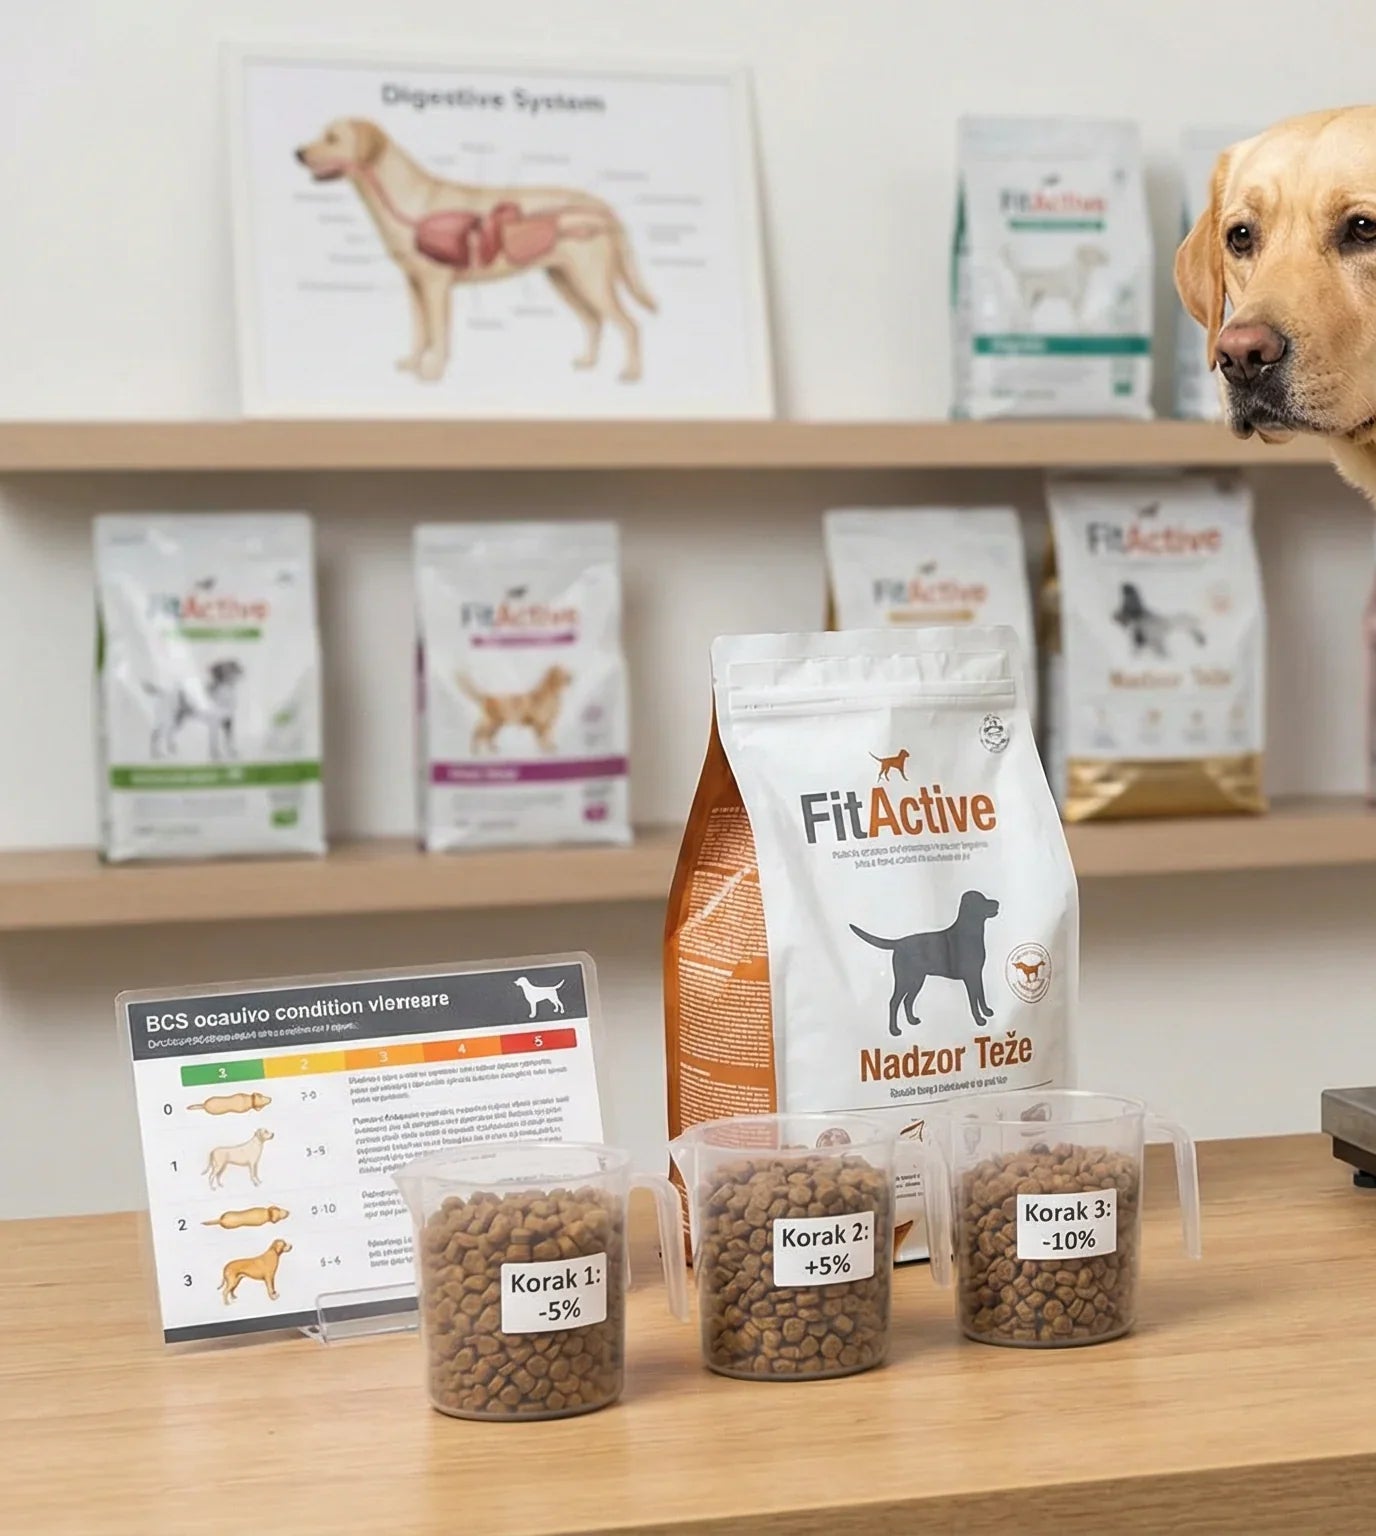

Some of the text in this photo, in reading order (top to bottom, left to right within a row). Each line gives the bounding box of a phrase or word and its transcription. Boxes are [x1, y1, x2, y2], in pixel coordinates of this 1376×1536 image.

[382, 83, 606, 117] Digestive System
[1087, 520, 1222, 556] FitActive
[800, 784, 997, 845] FitActive
[146, 1012, 189, 1033] BCS
[194, 1006, 270, 1028] ocauivo
[275, 999, 364, 1021] condition
[300, 1058, 310, 1071] 2
[379, 1050, 389, 1062] 3
[458, 1043, 467, 1054] 4
[534, 1035, 544, 1047] 5
[861, 1030, 1033, 1083] Nadzor Teže
[163, 1103, 173, 1116] 0
[171, 1160, 178, 1172] 1
[1025, 1199, 1111, 1222] Korak 3:
[178, 1219, 188, 1231] 2
[782, 1222, 869, 1248] Korak 2:
[1042, 1228, 1096, 1251] -10%
[805, 1253, 851, 1276] +5%
[184, 1274, 193, 1287] 3
[511, 1266, 601, 1293] Korak 1:
[539, 1297, 581, 1321] -5%
